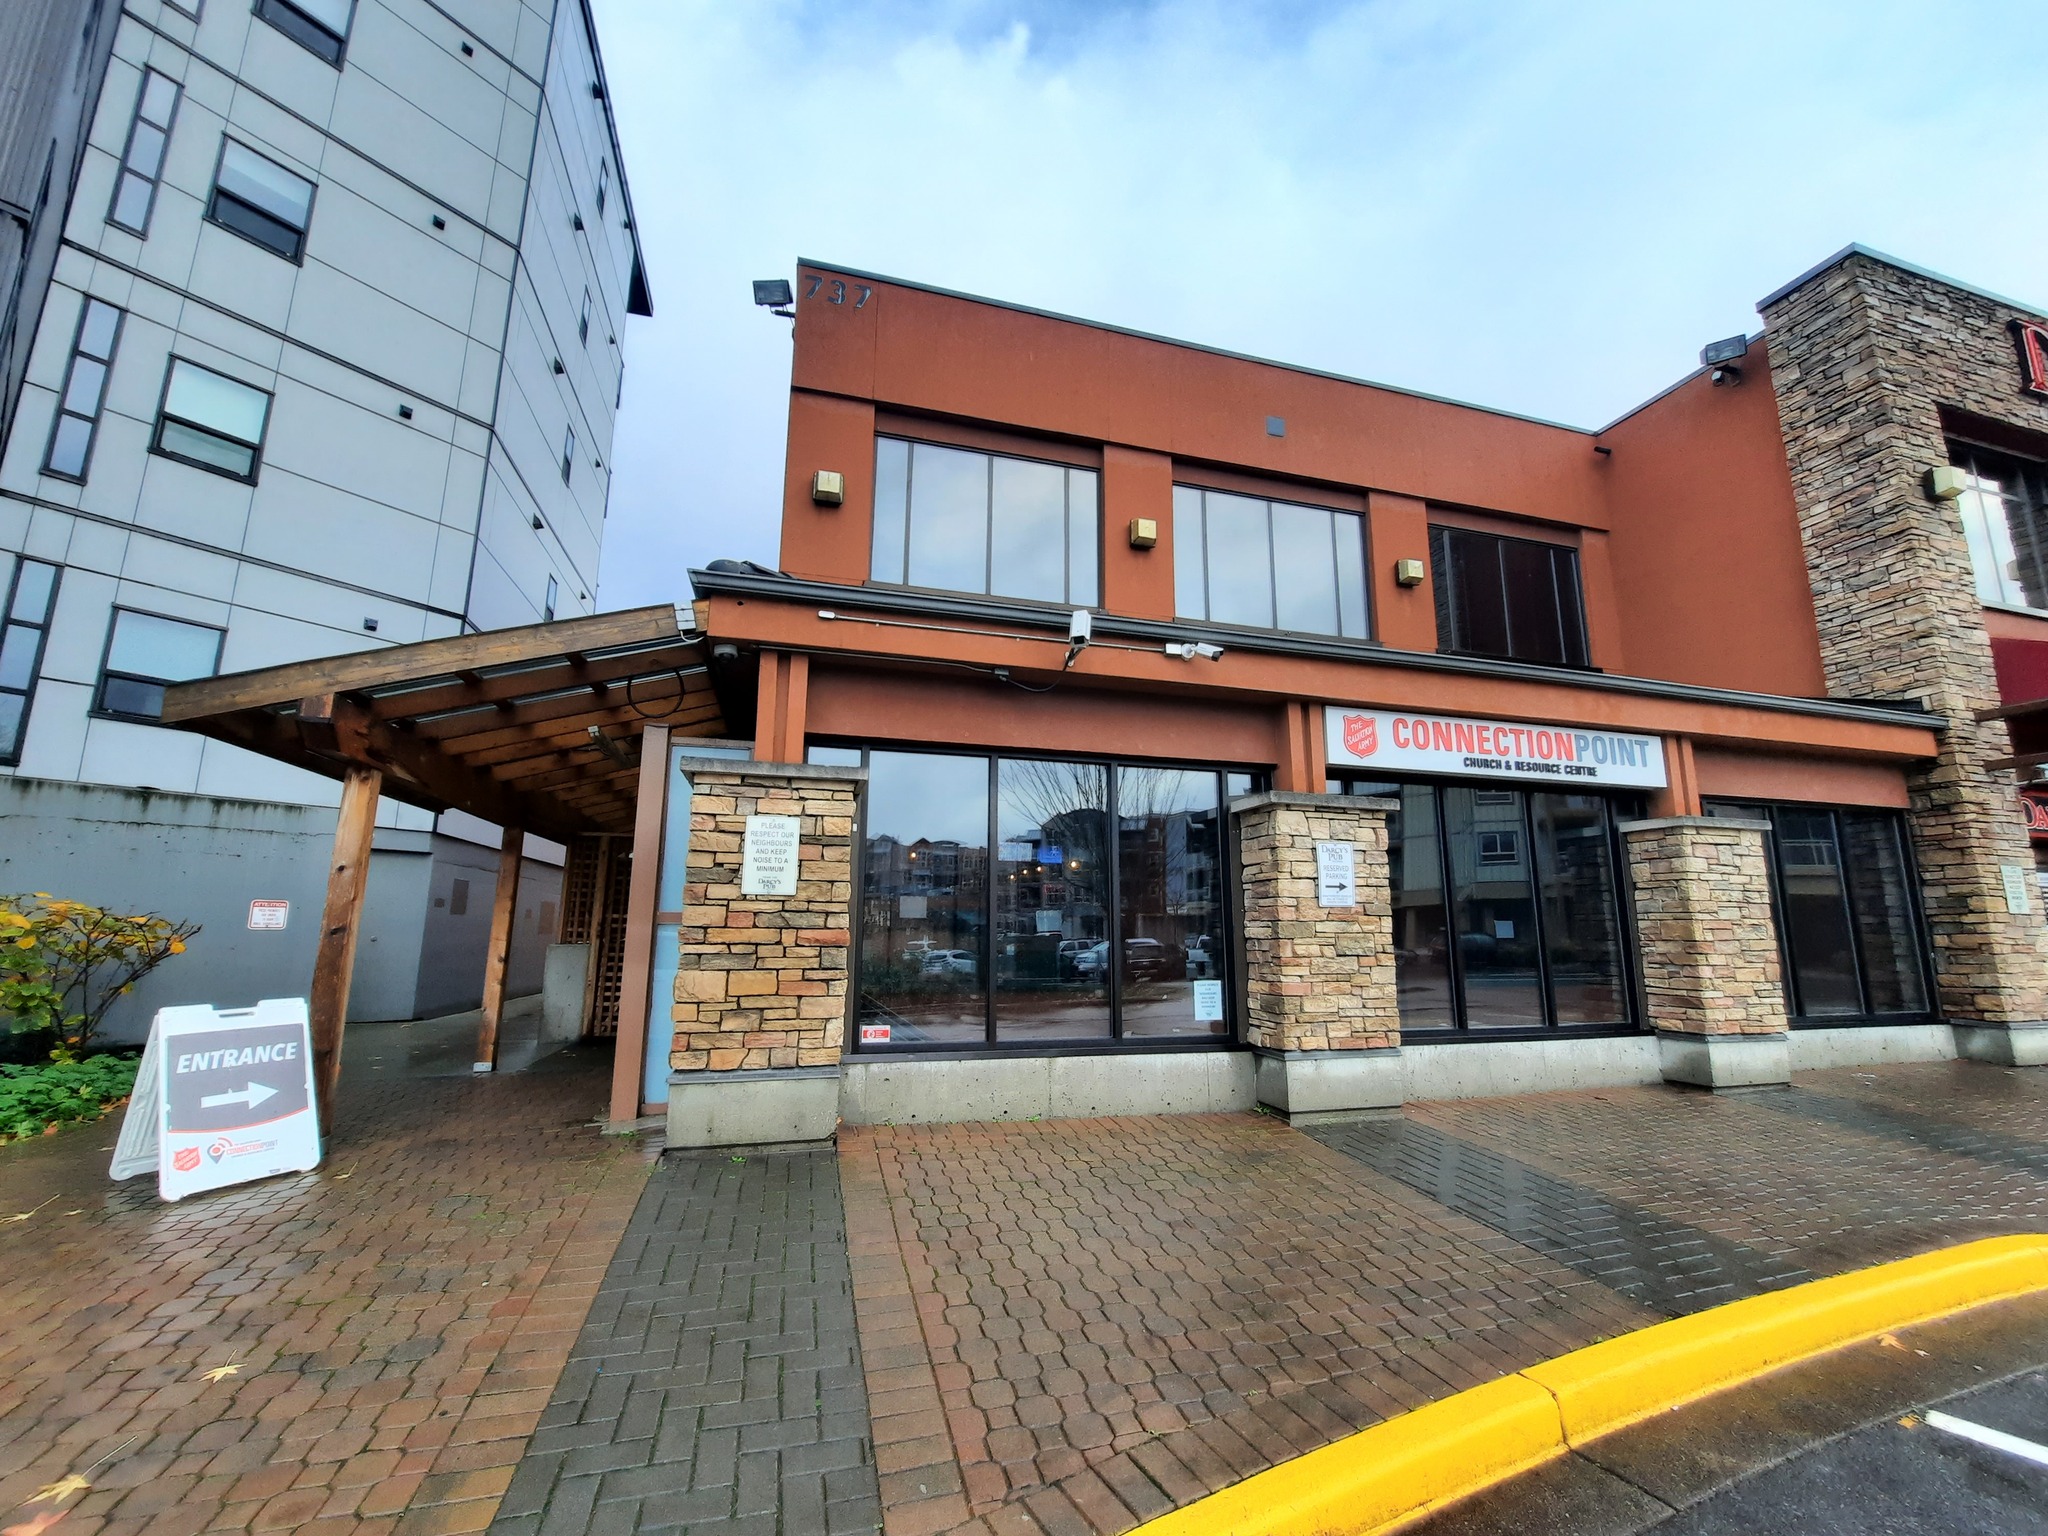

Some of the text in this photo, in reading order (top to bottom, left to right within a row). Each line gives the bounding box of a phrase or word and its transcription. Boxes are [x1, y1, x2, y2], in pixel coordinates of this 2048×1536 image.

[805, 275, 872, 308] 737
[1350, 720, 1363, 732] THE
[1347, 726, 1373, 746] SALVATION
[1357, 735, 1374, 751] ARMY
[1392, 717, 1649, 767] CONNECTIONPOINT
[1463, 757, 1598, 777] CHURCH & RESOURCE CENTRE
[750, 830, 779, 838] RESPECT
[751, 839, 793, 847] NEIGHBOURS
[1328, 853, 1343, 861] PUB
[176, 1042, 297, 1074] ENTRANCE
